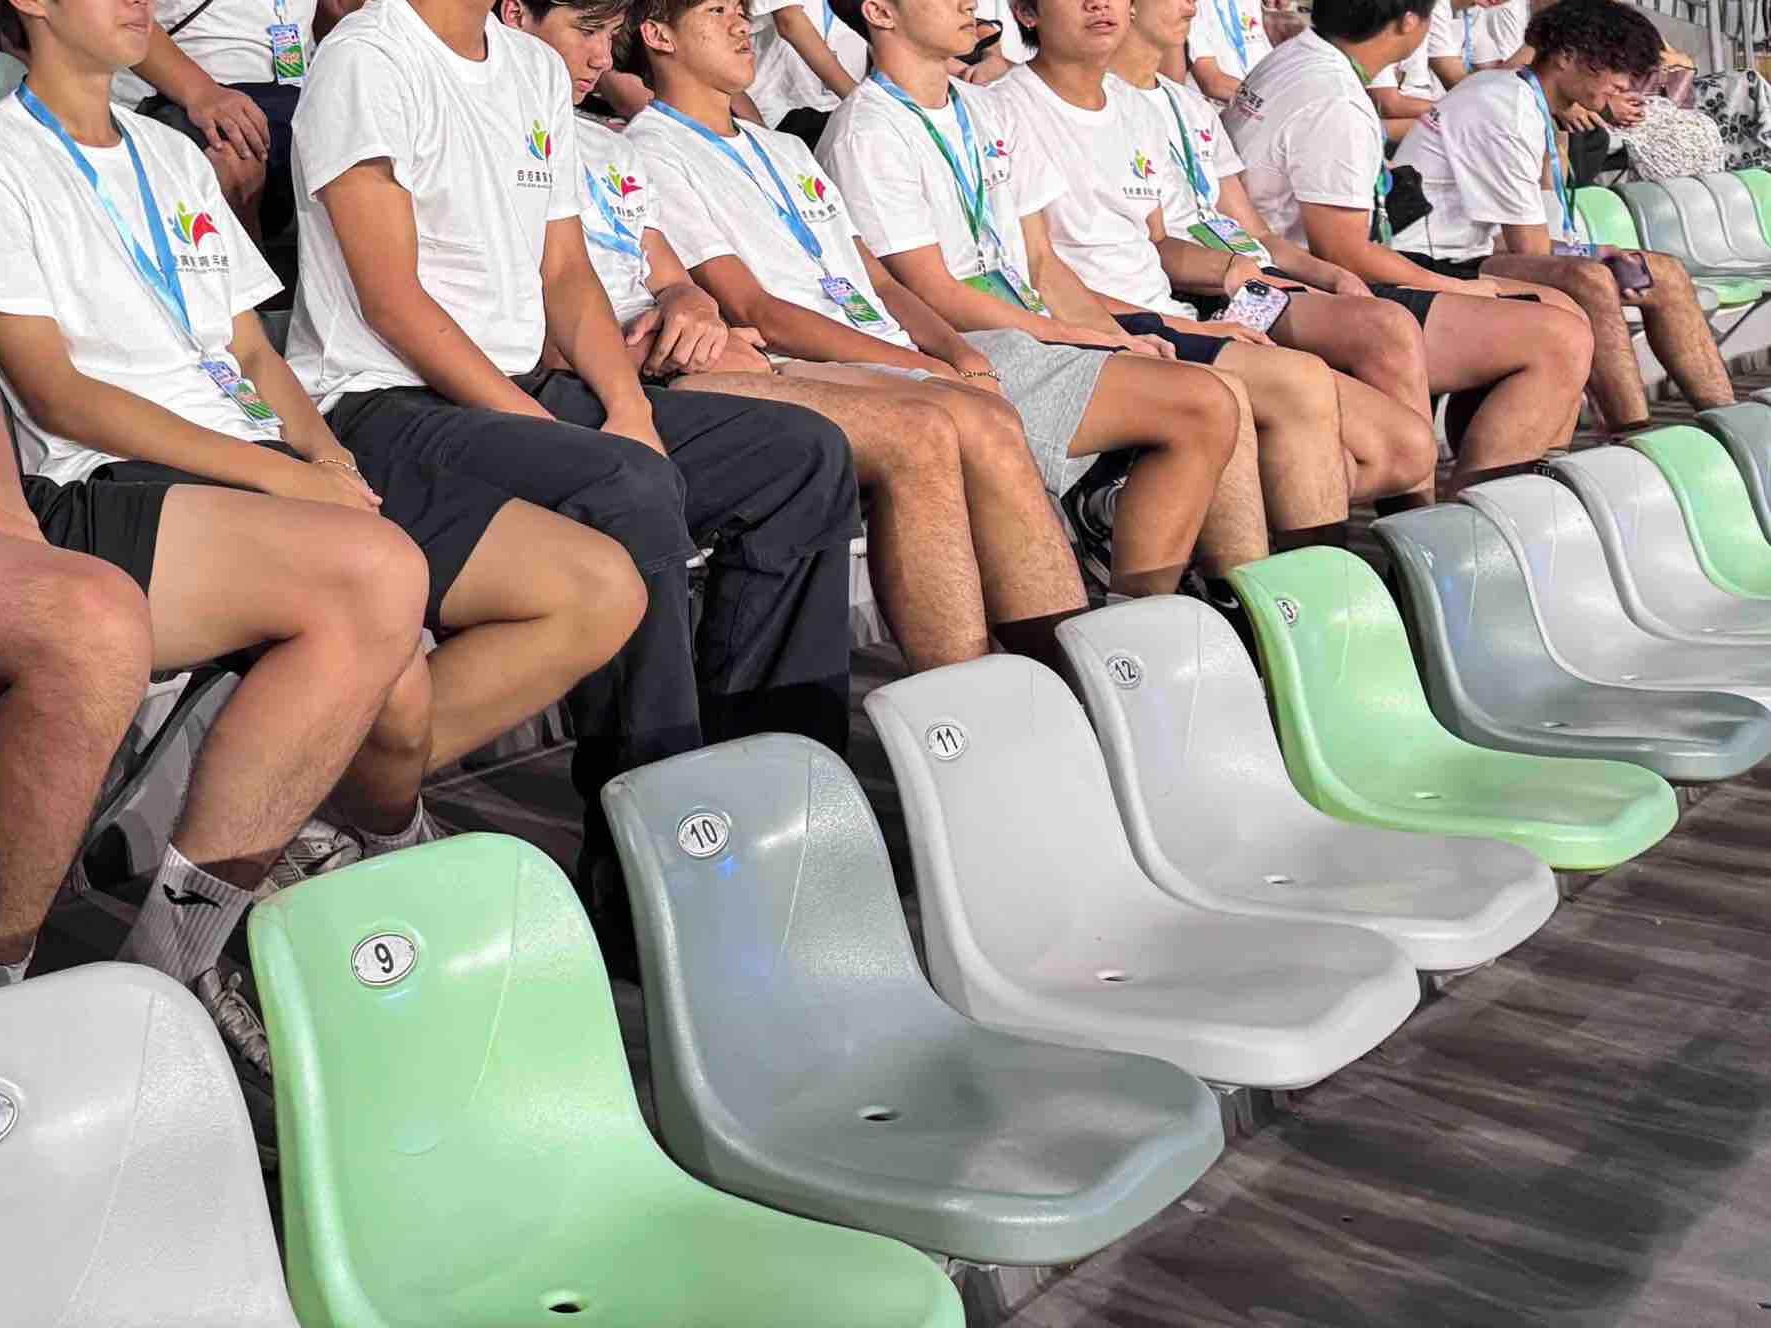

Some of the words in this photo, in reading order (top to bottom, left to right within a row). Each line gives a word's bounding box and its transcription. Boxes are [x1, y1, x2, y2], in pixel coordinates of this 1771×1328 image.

[1115, 660, 1136, 681] 12
[937, 727, 958, 753] 11
[690, 819, 718, 849] 10
[374, 943, 394, 974] 9
